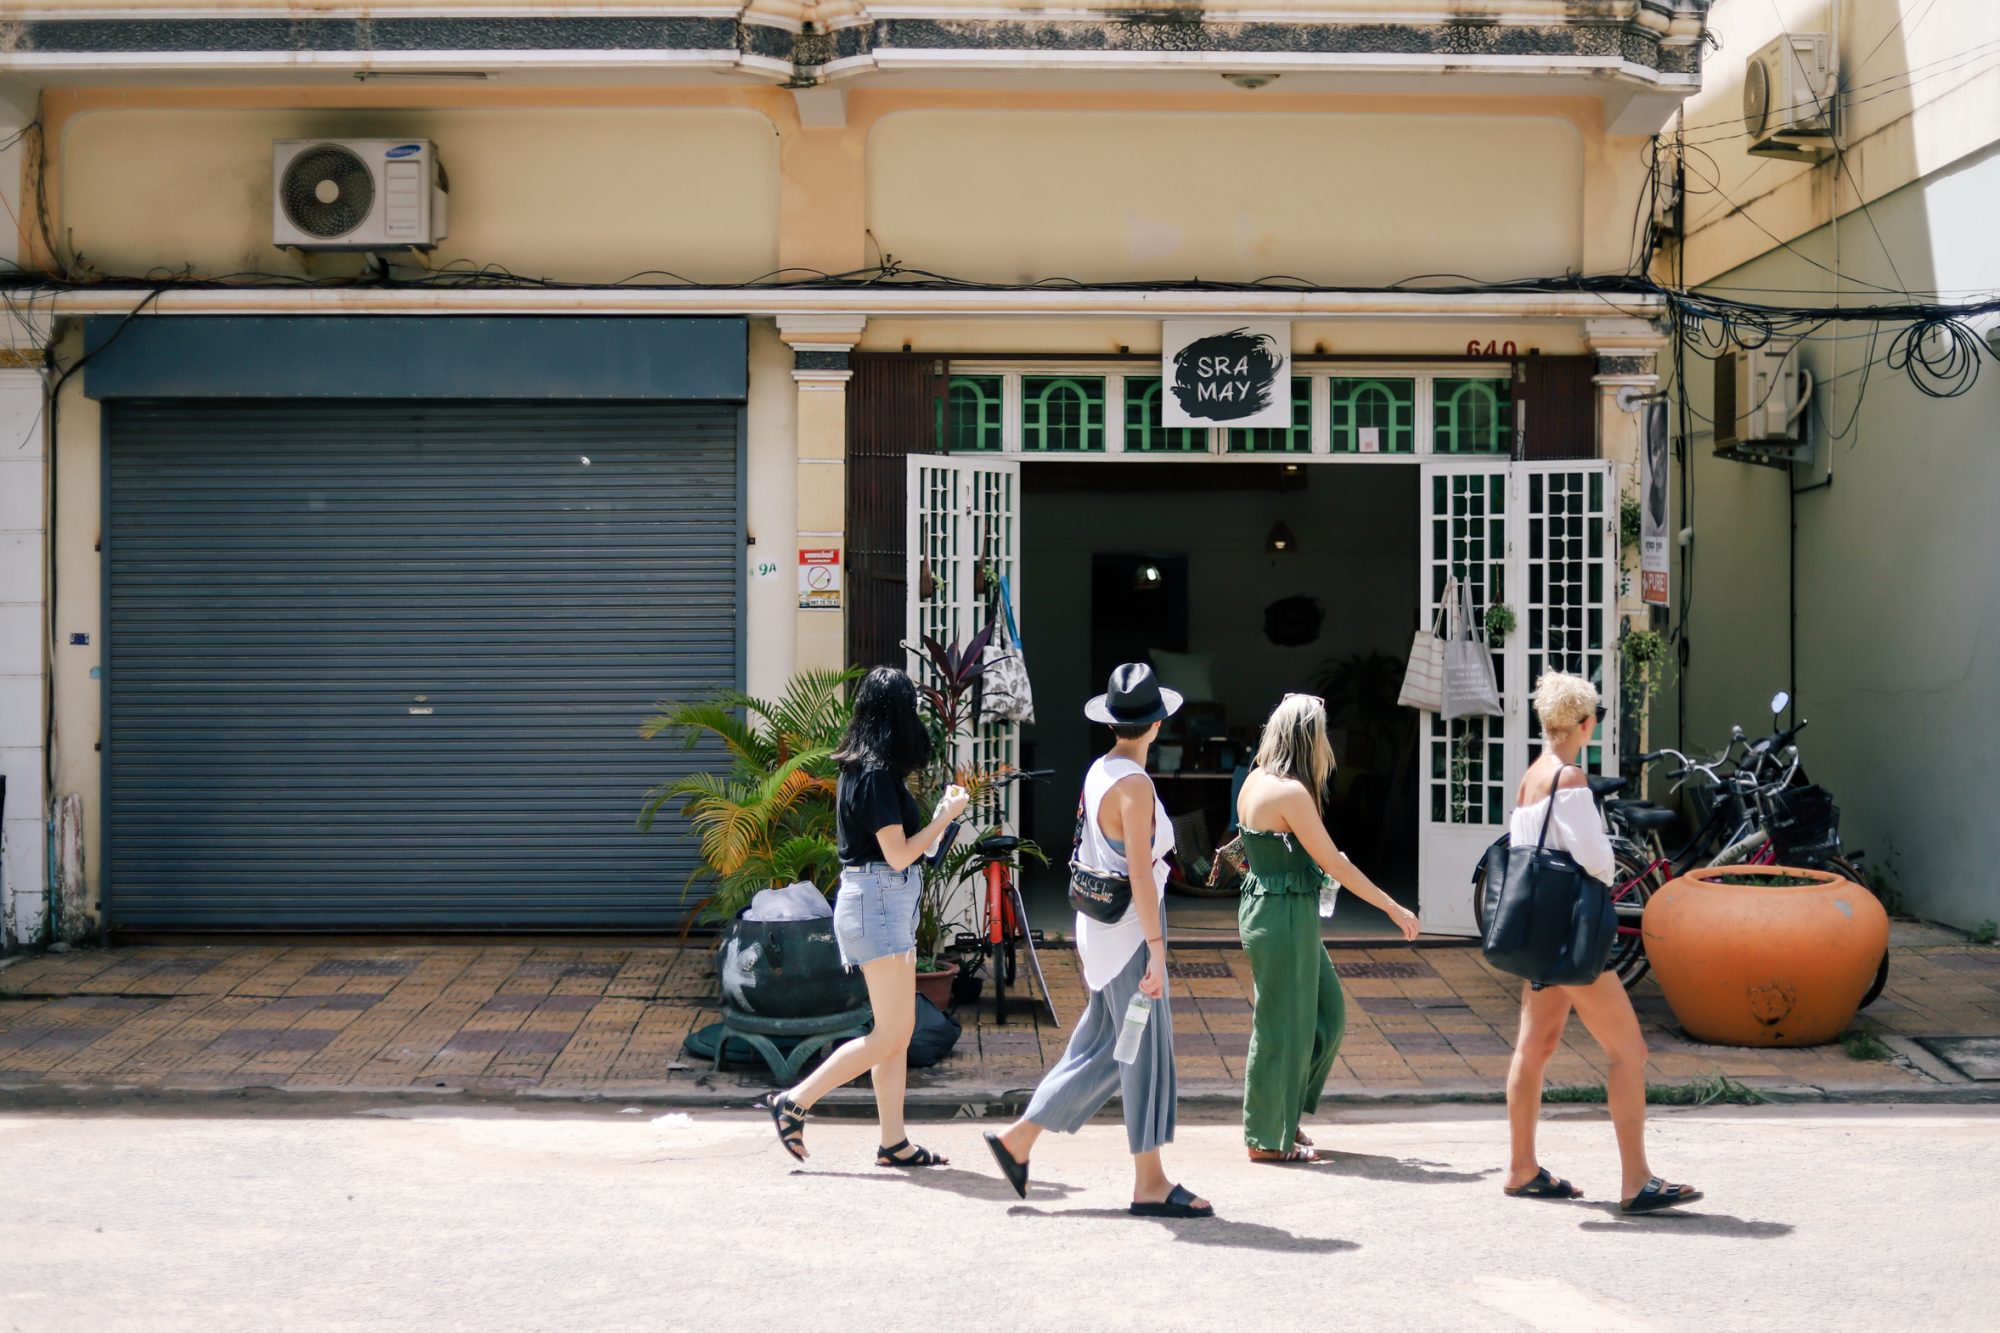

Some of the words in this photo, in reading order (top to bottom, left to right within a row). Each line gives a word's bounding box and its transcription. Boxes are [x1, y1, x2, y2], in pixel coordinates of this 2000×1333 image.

[1467, 340, 1518, 356] 640
[1197, 356, 1248, 377] SRA
[1198, 381, 1251, 402] MAY
